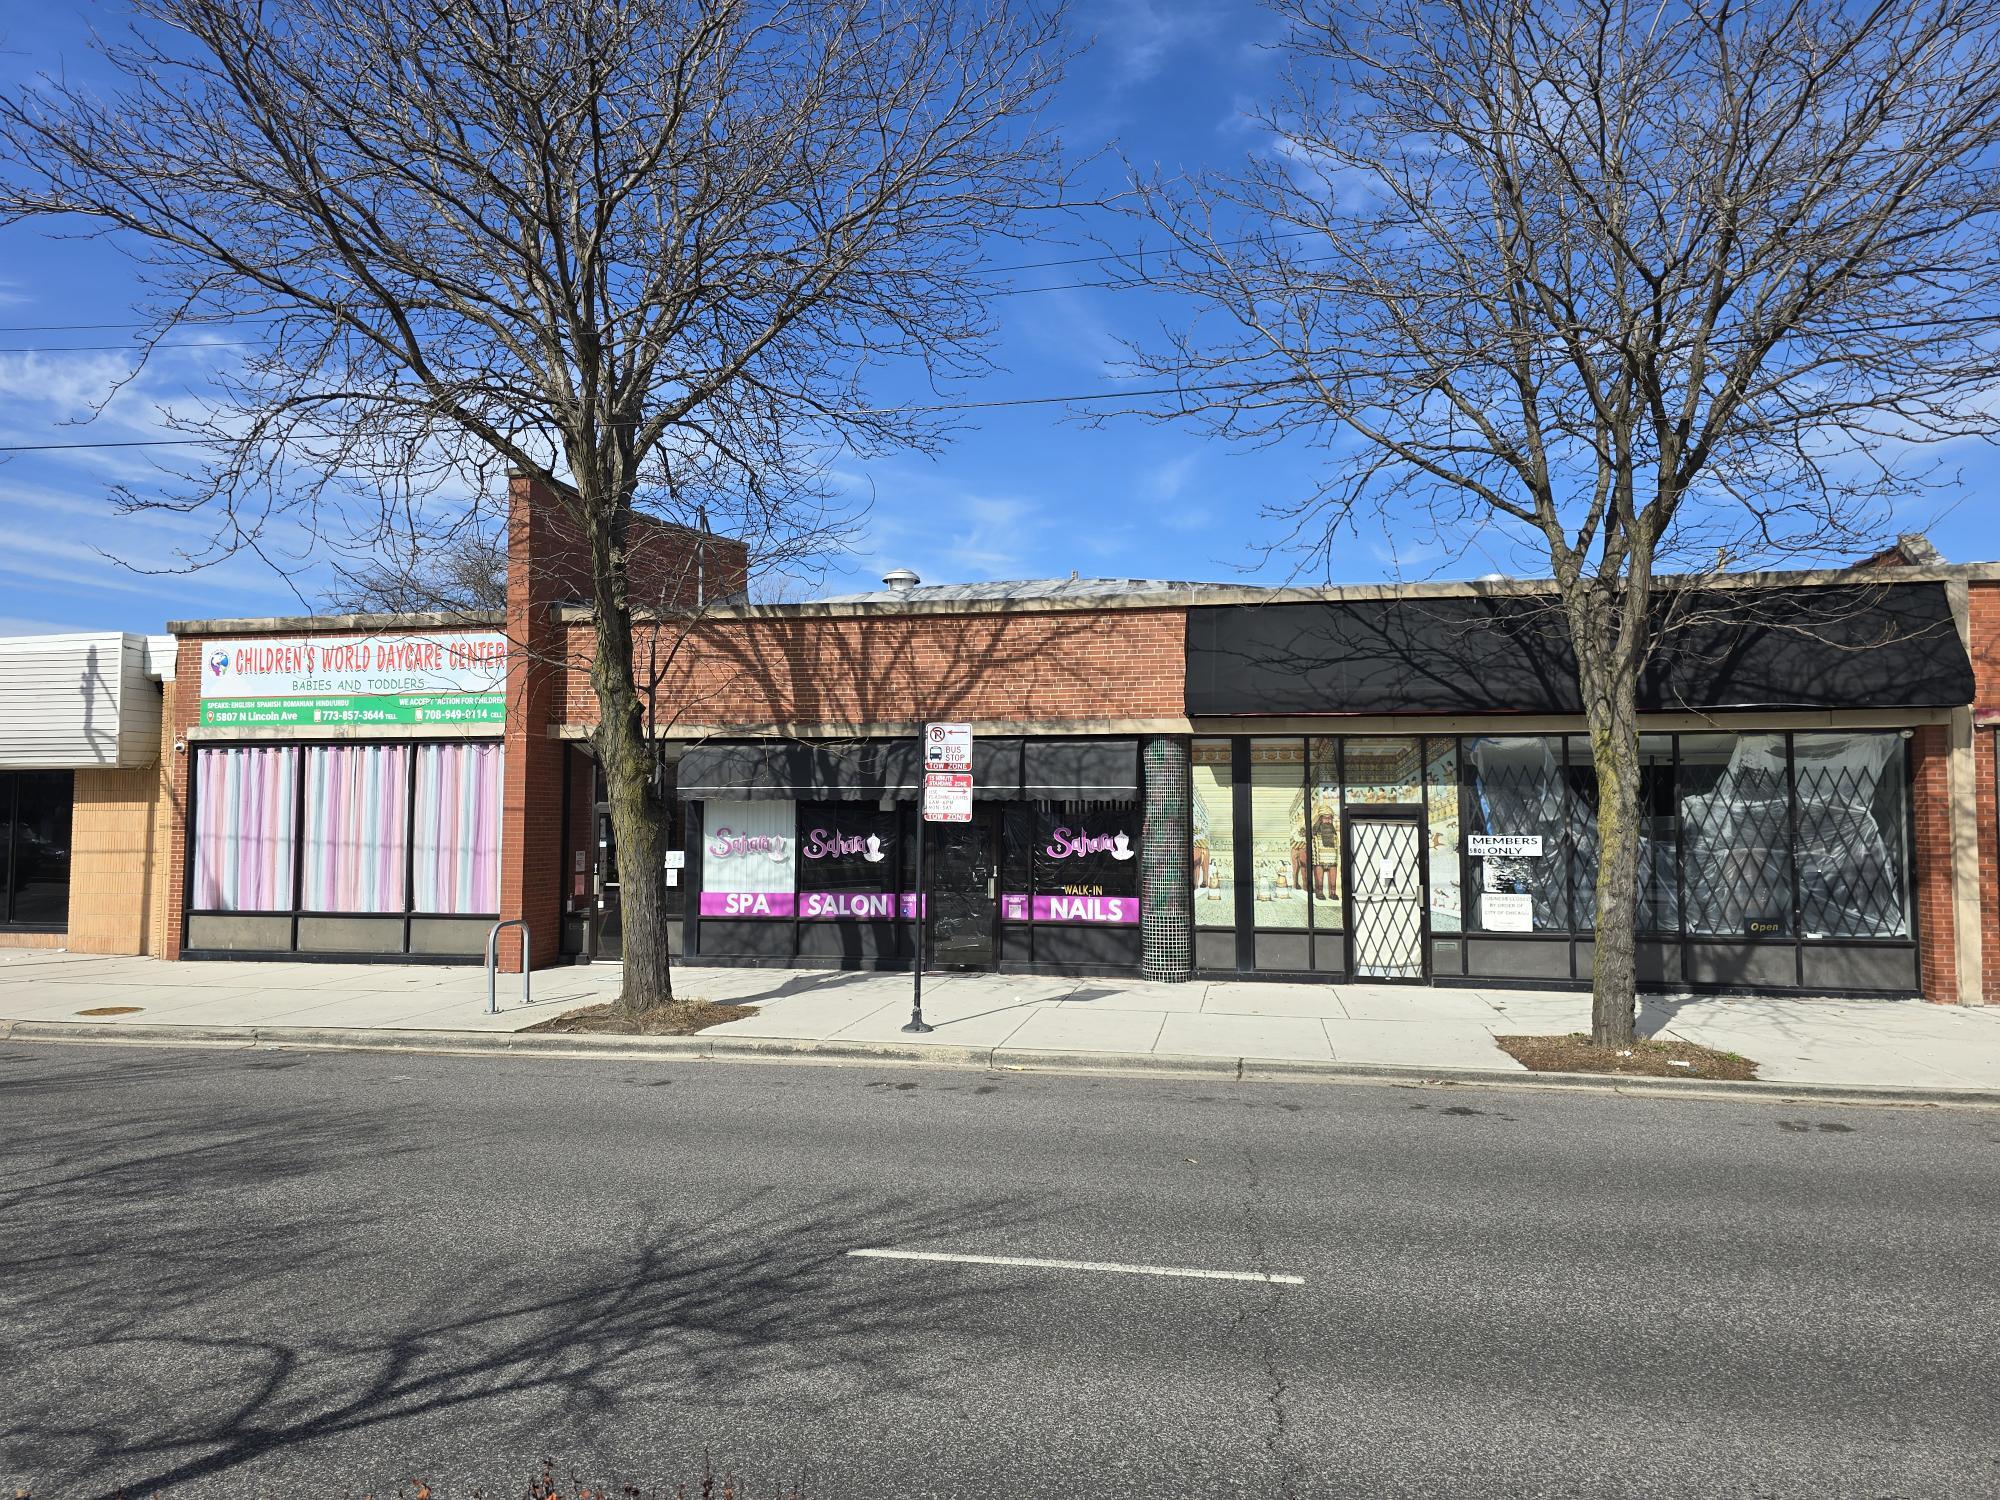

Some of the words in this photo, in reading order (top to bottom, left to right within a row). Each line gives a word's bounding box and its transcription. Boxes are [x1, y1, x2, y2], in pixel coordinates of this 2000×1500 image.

[236, 646, 315, 674] CHILDREN'S
[322, 644, 371, 672] WORLD
[377, 642, 442, 672] DAYCARE
[449, 641, 505, 669] CENTER
[292, 680, 332, 691] BABIES
[337, 679, 362, 690] AND
[368, 678, 425, 689] TODDLERS
[399, 698, 409, 706] WE
[409, 697, 434, 705] ACCEPT
[461, 696, 474, 704] FOR
[216, 711, 238, 721] 5807
[239, 711, 247, 721] N
[247, 710, 279, 721] Lincoln
[280, 710, 298, 721] Ave
[323, 709, 385, 721] 773-857-3644
[709, 827, 772, 858] Sahara
[803, 828, 868, 858] Sahara
[1046, 827, 1116, 858] Sahara
[1472, 837, 1538, 845] MEMBERS
[1487, 847, 1522, 855] ONLY
[1064, 885, 1103, 896] WALK-IN
[724, 893, 771, 914] SPA
[807, 894, 888, 916] SALON
[1050, 897, 1123, 921] NAILS
[1751, 922, 1778, 932] Open
